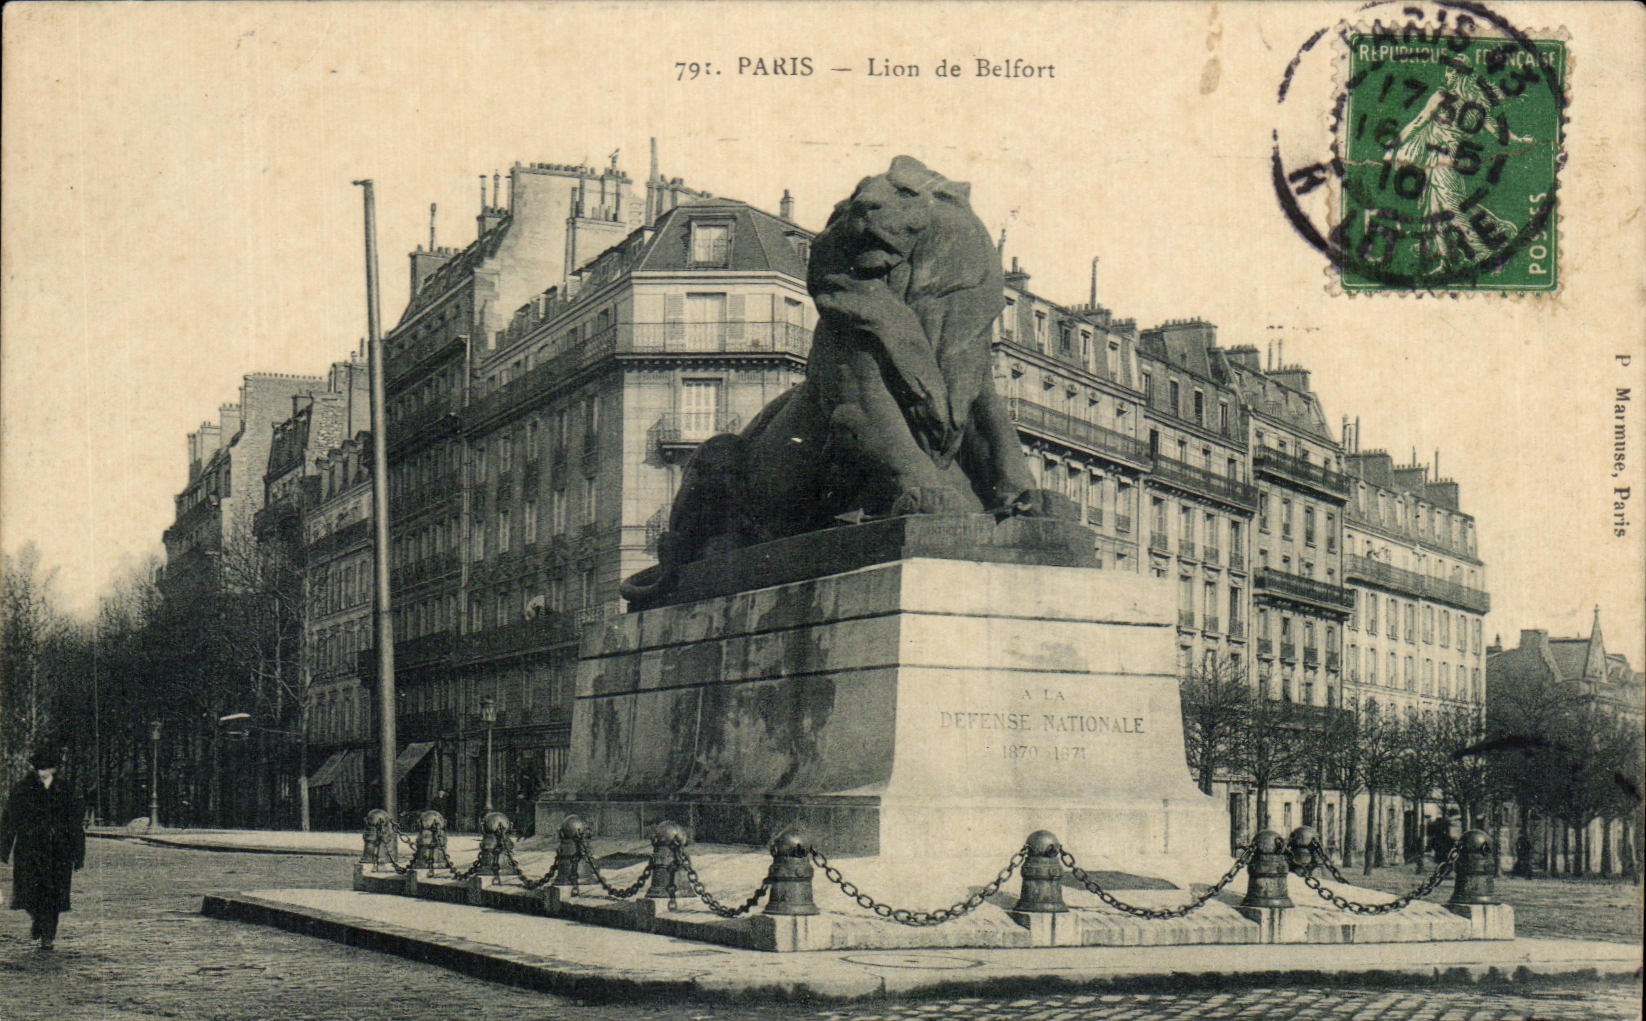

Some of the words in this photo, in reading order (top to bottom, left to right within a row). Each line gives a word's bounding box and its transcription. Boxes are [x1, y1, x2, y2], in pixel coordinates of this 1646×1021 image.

[1475, 48, 1556, 70] FNÇASE
[1043, 688, 1066, 702] LA
[940, 711, 1032, 732] DEFENSE
[1043, 714, 1145, 734] NATIONALE
[1003, 745, 1039, 761] 1870
